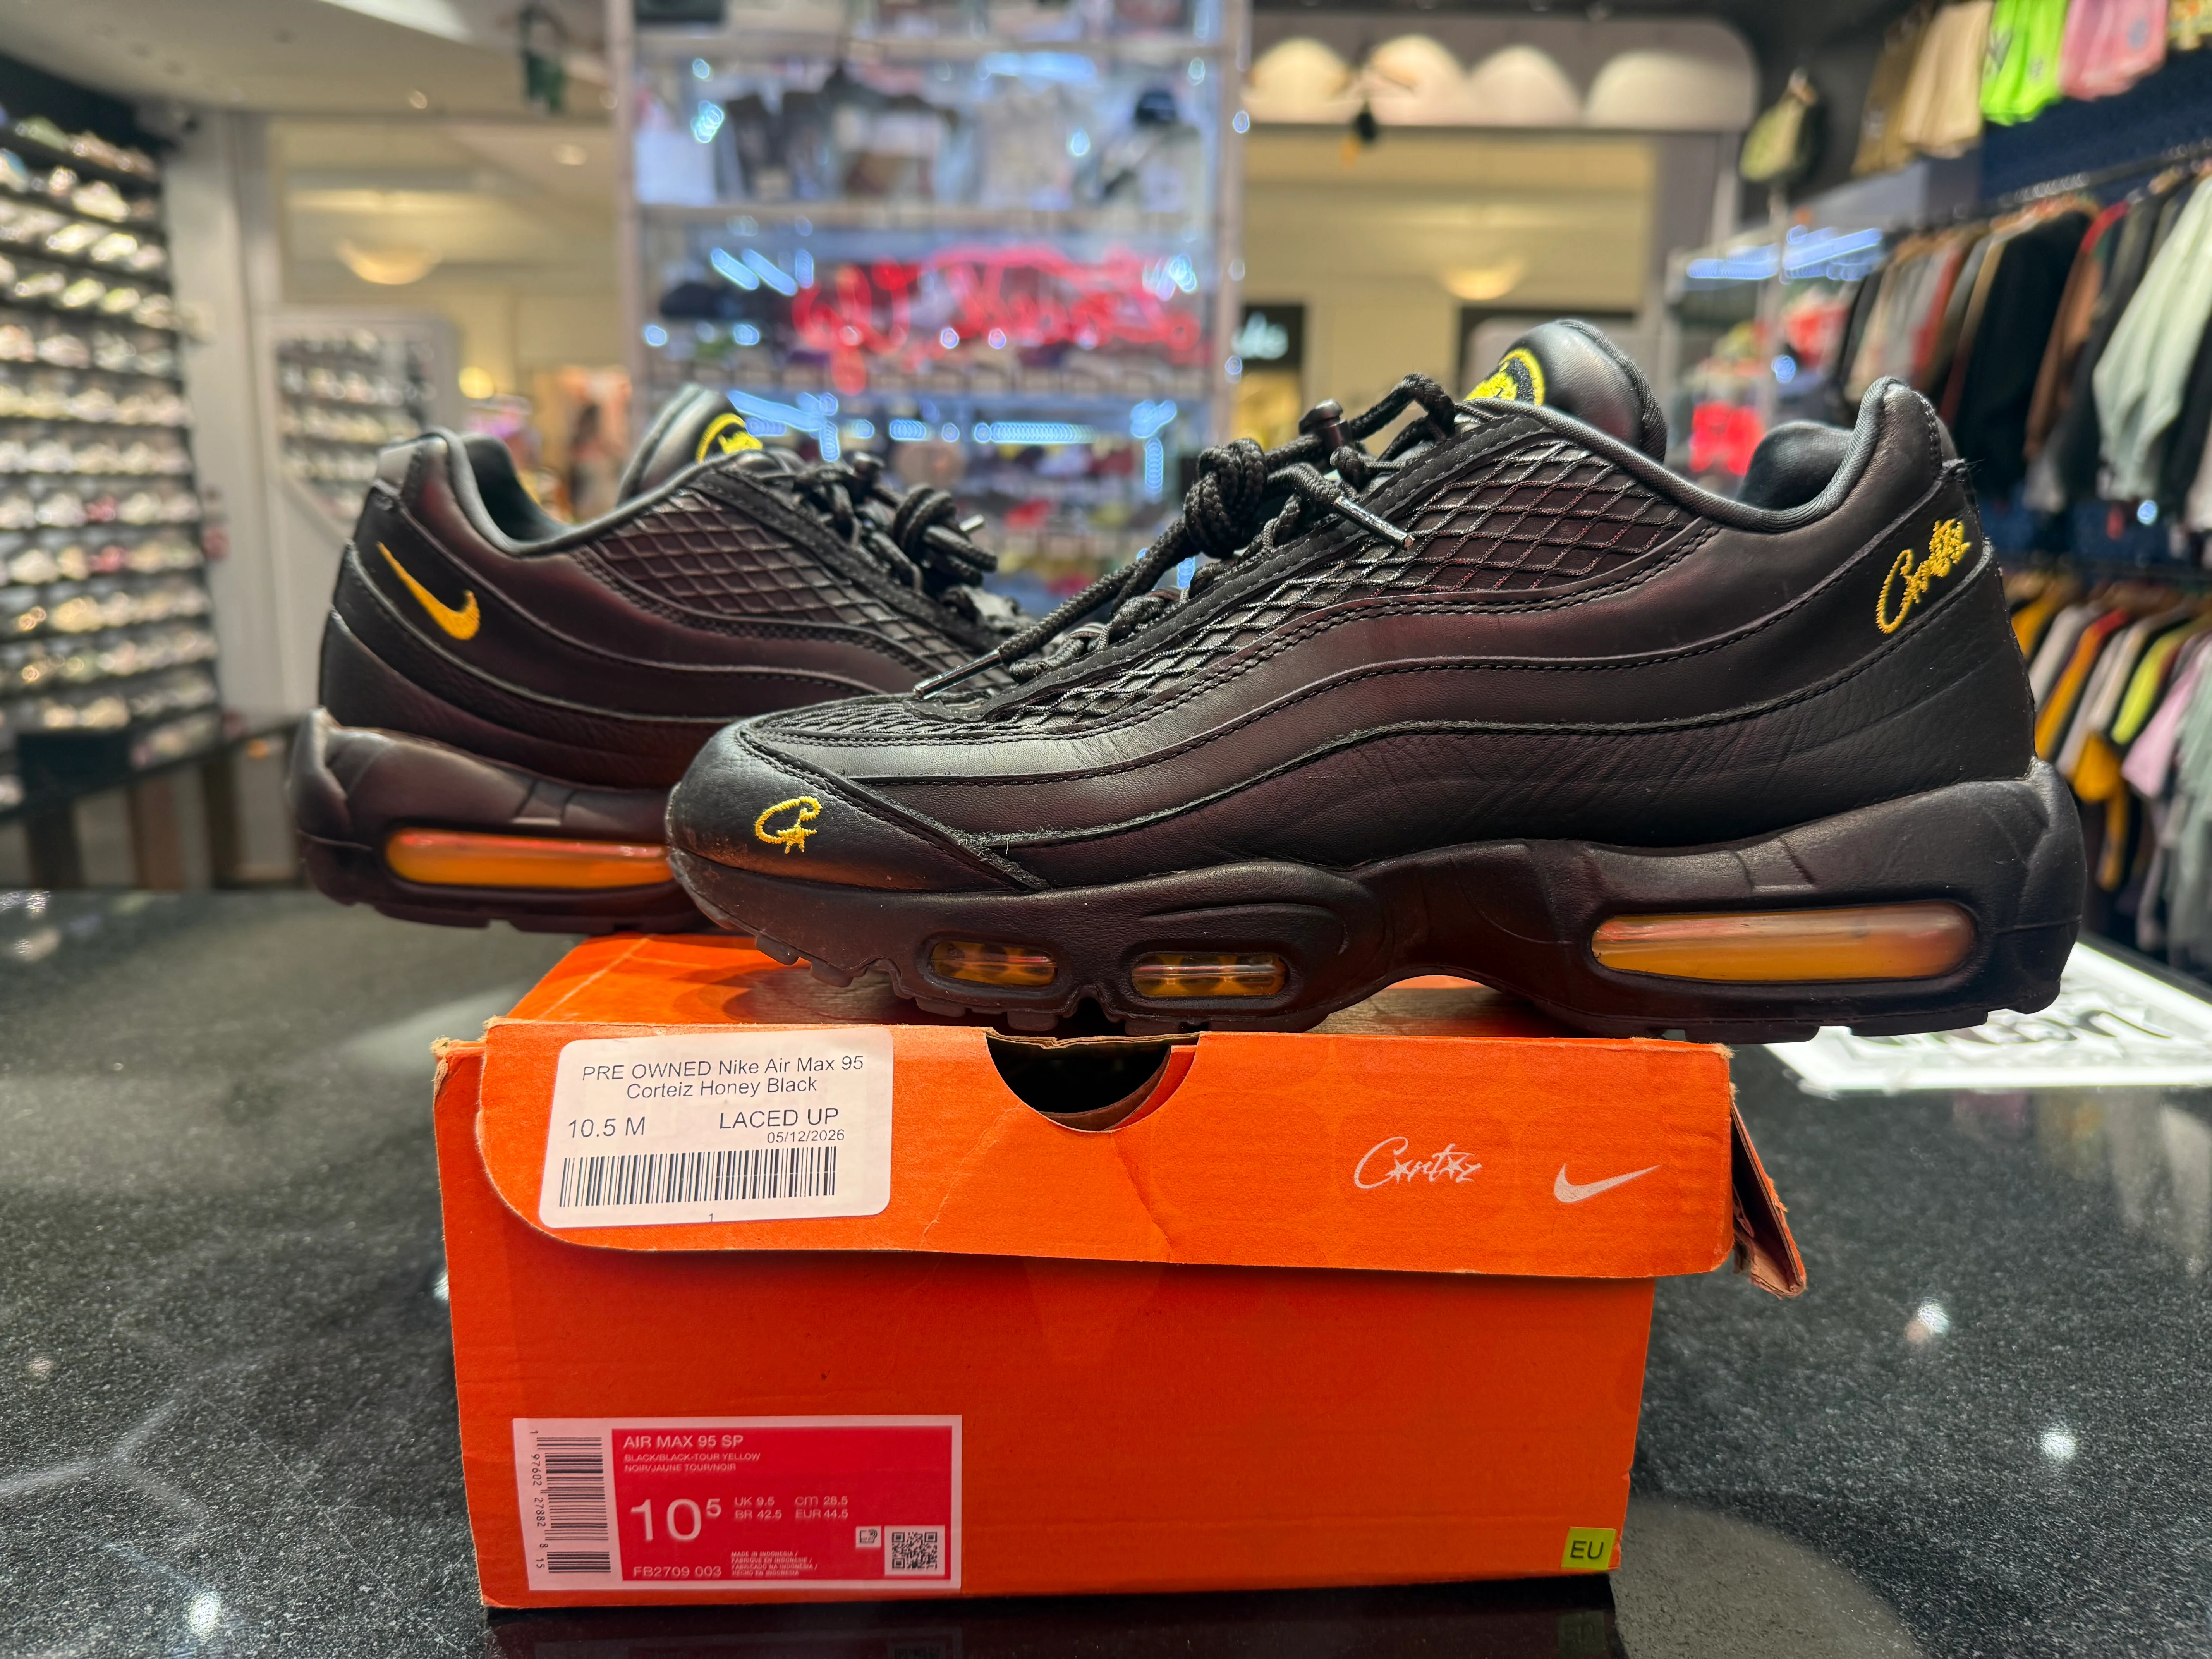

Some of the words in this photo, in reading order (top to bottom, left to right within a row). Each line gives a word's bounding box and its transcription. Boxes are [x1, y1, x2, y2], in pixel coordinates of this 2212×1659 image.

[582, 1065, 624, 1080] PRE
[632, 1061, 711, 1079] OWNED
[719, 1060, 759, 1075] Nike
[764, 1058, 790, 1073] Air
[797, 1057, 835, 1072] Max
[842, 1056, 864, 1070] 95
[627, 1082, 693, 1099] Corteiz
[701, 1080, 761, 1097] Honey
[768, 1076, 817, 1093] Black
[720, 1109, 798, 1129] LACED
[808, 1108, 839, 1126] UP
[568, 1118, 616, 1138] 10.5
[625, 1116, 645, 1136] M
[767, 1129, 845, 1143] 05/12/2026
[623, 1436, 651, 1449] AIR
[656, 1435, 693, 1448] MAX
[698, 1435, 716, 1448] 95
[721, 1434, 744, 1448] SP
[624, 1453, 720, 1462] BLACK/BLACK-TOUR
[722, 1452, 761, 1461] YELLOW
[531, 1454, 542, 1486] 97602
[625, 1464, 682, 1472] NOIR/JAUNE
[684, 1463, 736, 1472] TOUR/NOIR
[734, 1496, 752, 1507] UK
[756, 1496, 775, 1507] 9.5
[823, 1496, 848, 1506] 28.5
[534, 1498, 546, 1527] 27882
[630, 1499, 702, 1541] 10
[706, 1498, 721, 1517] 5
[735, 1510, 752, 1520] BR
[757, 1509, 782, 1520] 42.5
[795, 1509, 821, 1519] EUR
[824, 1508, 848, 1519] 44.5
[1570, 1540, 1604, 1559] EU
[536, 1558, 544, 1568] 15
[634, 1566, 690, 1578] FB2709
[694, 1566, 722, 1577] 003
